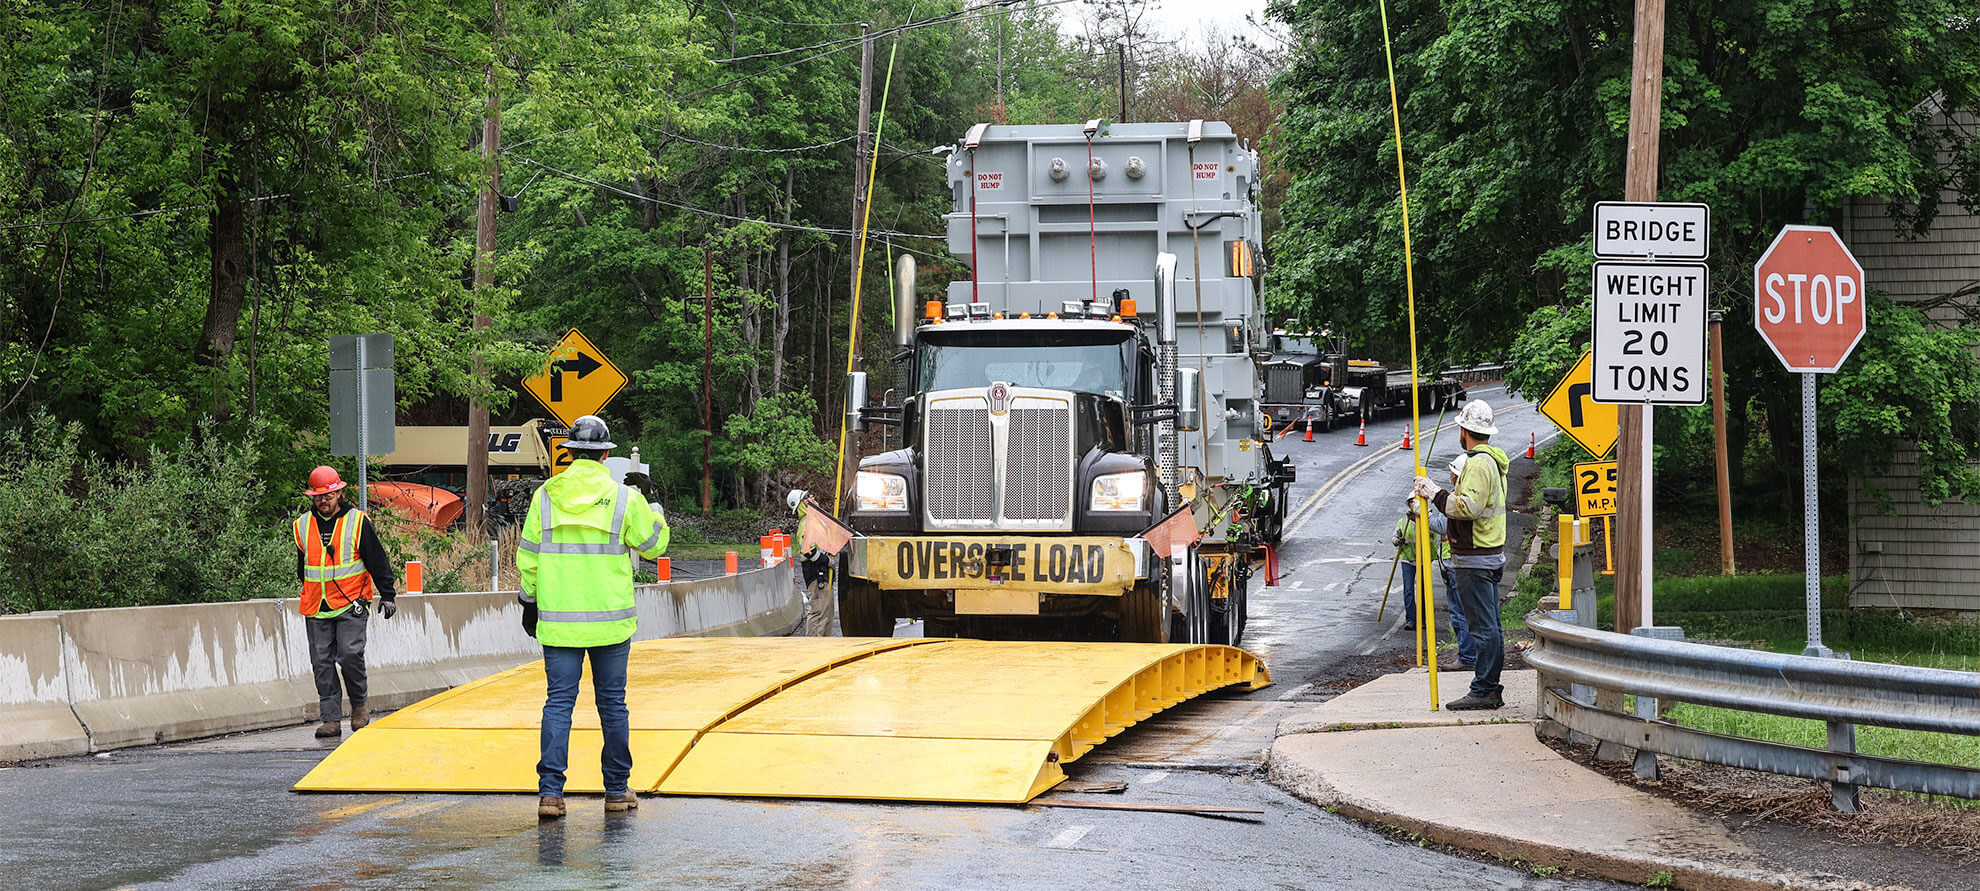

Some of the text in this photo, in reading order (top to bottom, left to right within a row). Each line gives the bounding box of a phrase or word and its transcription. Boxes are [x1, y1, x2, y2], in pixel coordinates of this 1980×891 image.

[977, 173, 1003, 181] DO NOT
[1193, 163, 1204, 171] DO
[1196, 171, 1216, 179] HUMP
[1606, 220, 1696, 242] BRIDGE
[1606, 274, 1697, 297] WEIGHT
[1763, 272, 1857, 325] STOP
[1618, 302, 1682, 324] LIMIT
[1622, 329, 1669, 356] 20
[1608, 365, 1690, 392] TONS
[488, 432, 522, 453] LG
[555, 445, 573, 466] 2
[1580, 468, 1617, 494] 25
[1033, 543, 1106, 584] LOAD
